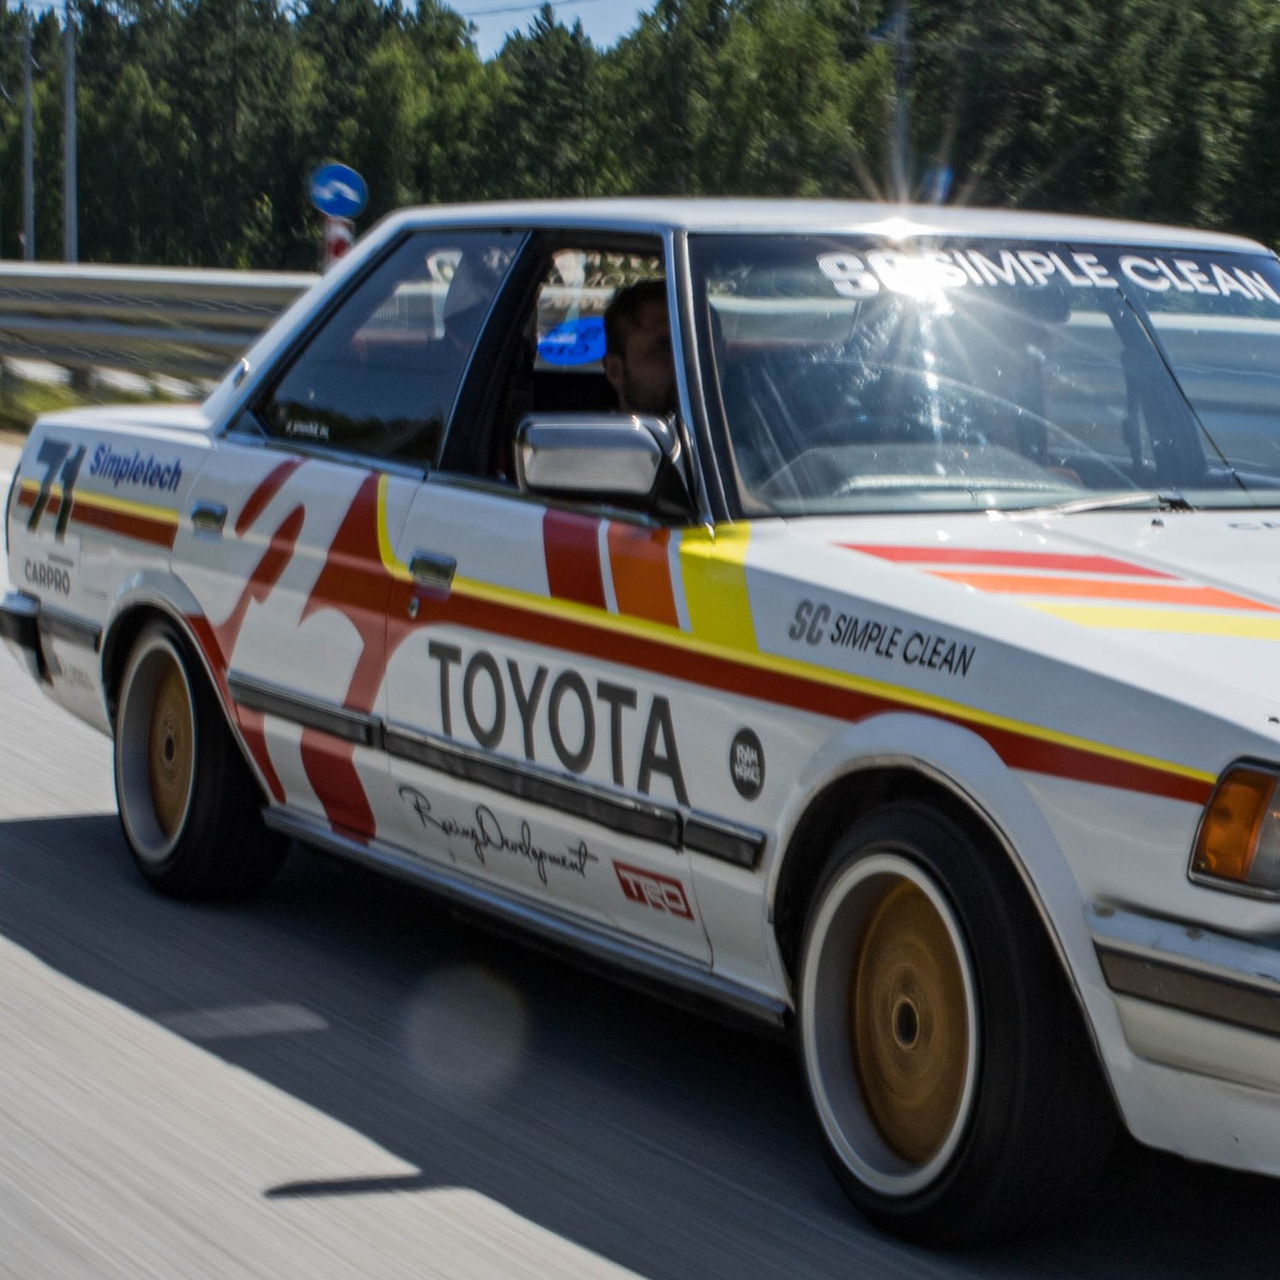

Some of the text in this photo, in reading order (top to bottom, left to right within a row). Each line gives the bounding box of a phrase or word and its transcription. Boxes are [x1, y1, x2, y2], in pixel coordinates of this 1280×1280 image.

[932, 249, 1118, 289] SIMPLE
[27, 437, 87, 544] 71
[89, 442, 183, 493] Simpletech
[24, 558, 71, 596] CARPRO
[788, 599, 976, 677] SC SIMPLE CLEAN
[428, 639, 691, 808] TOYOTA
